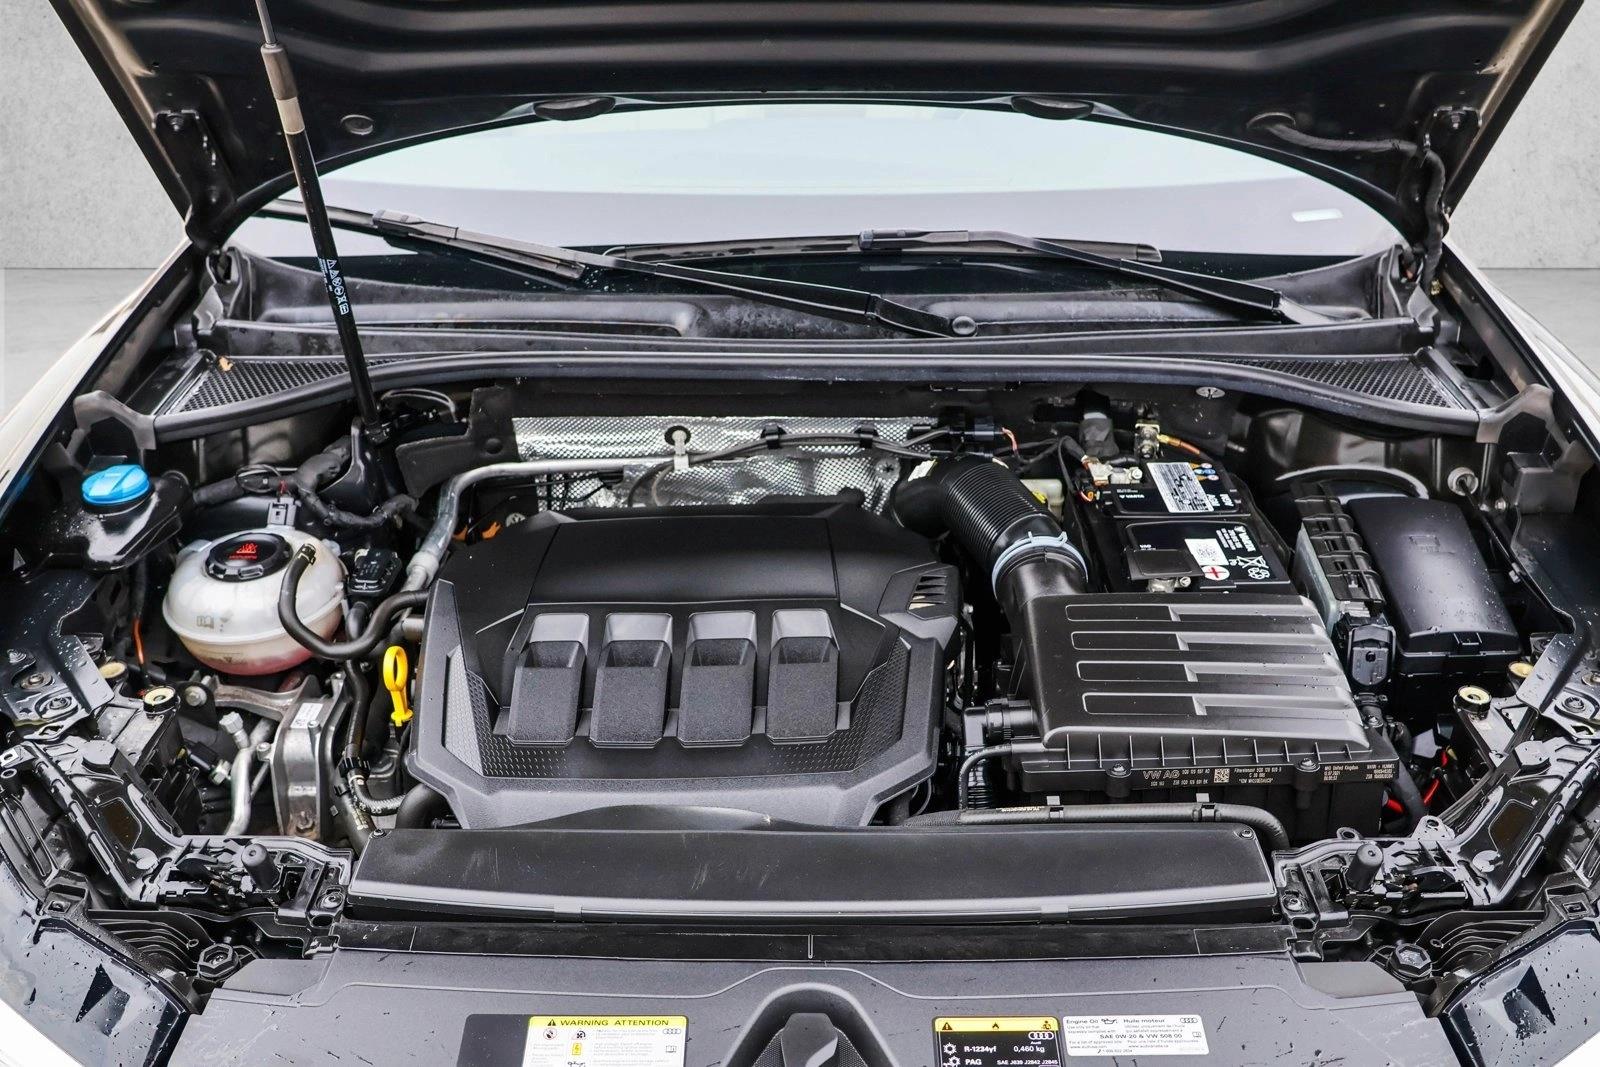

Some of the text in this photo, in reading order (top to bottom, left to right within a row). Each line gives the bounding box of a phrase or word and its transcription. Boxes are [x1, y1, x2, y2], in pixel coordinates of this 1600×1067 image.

[1143, 770, 1180, 780] VW AG
[1036, 1045, 1045, 1053] kg
